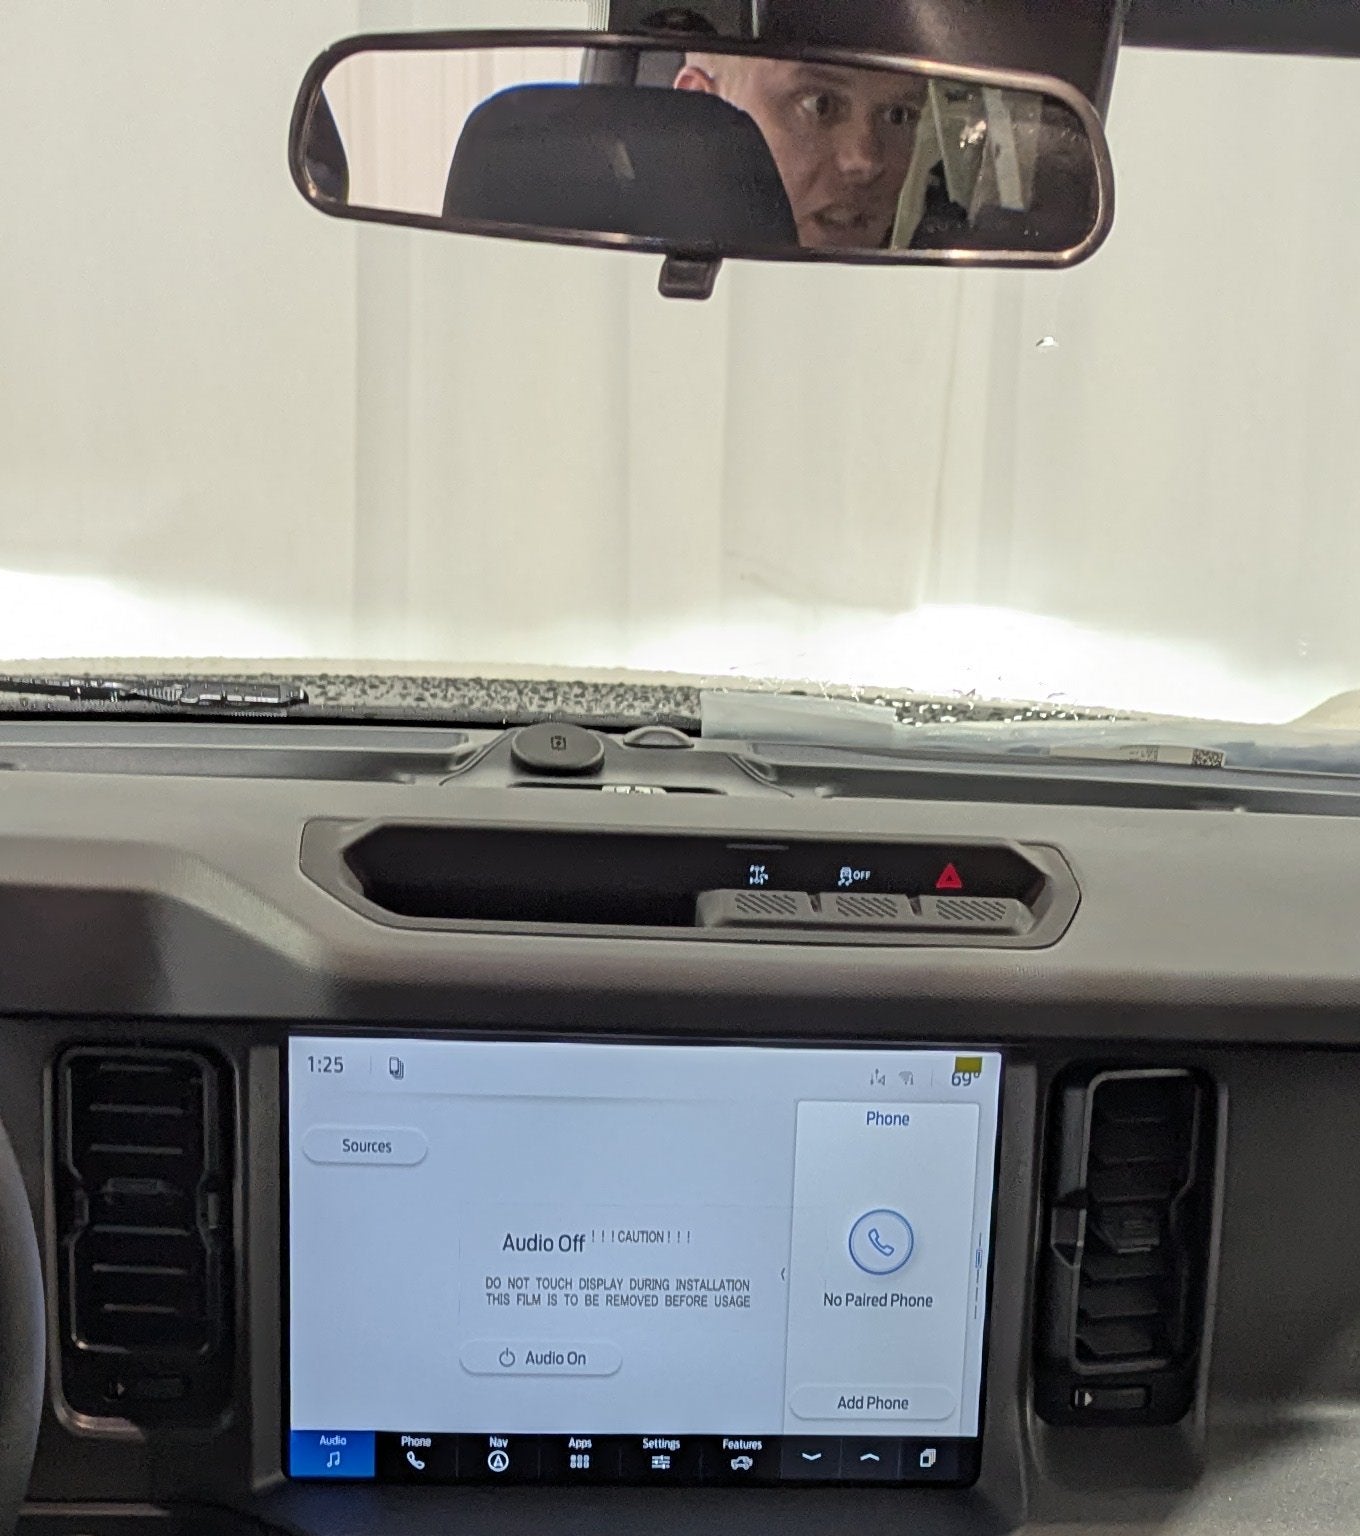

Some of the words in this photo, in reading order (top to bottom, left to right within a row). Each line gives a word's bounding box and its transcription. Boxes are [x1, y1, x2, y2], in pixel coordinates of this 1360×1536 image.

[853, 870, 871, 881] OFF
[307, 1055, 344, 1074] 1:25
[866, 1111, 910, 1126] Phone
[342, 1138, 392, 1154] Sources
[502, 1233, 554, 1252] Audio
[558, 1233, 586, 1253] Off
[486, 1277, 501, 1290] DO
[508, 1277, 530, 1290] NOT
[536, 1277, 572, 1291] TOUCH
[579, 1278, 624, 1291] DISPLAY
[630, 1278, 670, 1292] DURING
[676, 1279, 750, 1292] INSTALLATION
[486, 1293, 510, 1306] THIS
[516, 1293, 541, 1306] FILM
[548, 1294, 558, 1306] IS
[564, 1294, 578, 1306] TO
[584, 1294, 599, 1307] BE
[605, 1294, 659, 1307] REMOVED
[665, 1295, 708, 1308] BEFORE
[714, 1295, 751, 1308] USAGE
[823, 1292, 842, 1307] No
[845, 1292, 888, 1308] Paired
[890, 1293, 933, 1308] Phone
[525, 1350, 564, 1366] Audio
[567, 1351, 586, 1365] On
[837, 1396, 864, 1410] Add
[867, 1396, 909, 1410] Phone
[319, 1435, 347, 1446] Audio
[401, 1436, 432, 1447] Phone
[489, 1437, 509, 1448] Nav
[568, 1438, 592, 1450] Apps
[642, 1438, 681, 1451] Settings
[722, 1438, 763, 1450] Features
